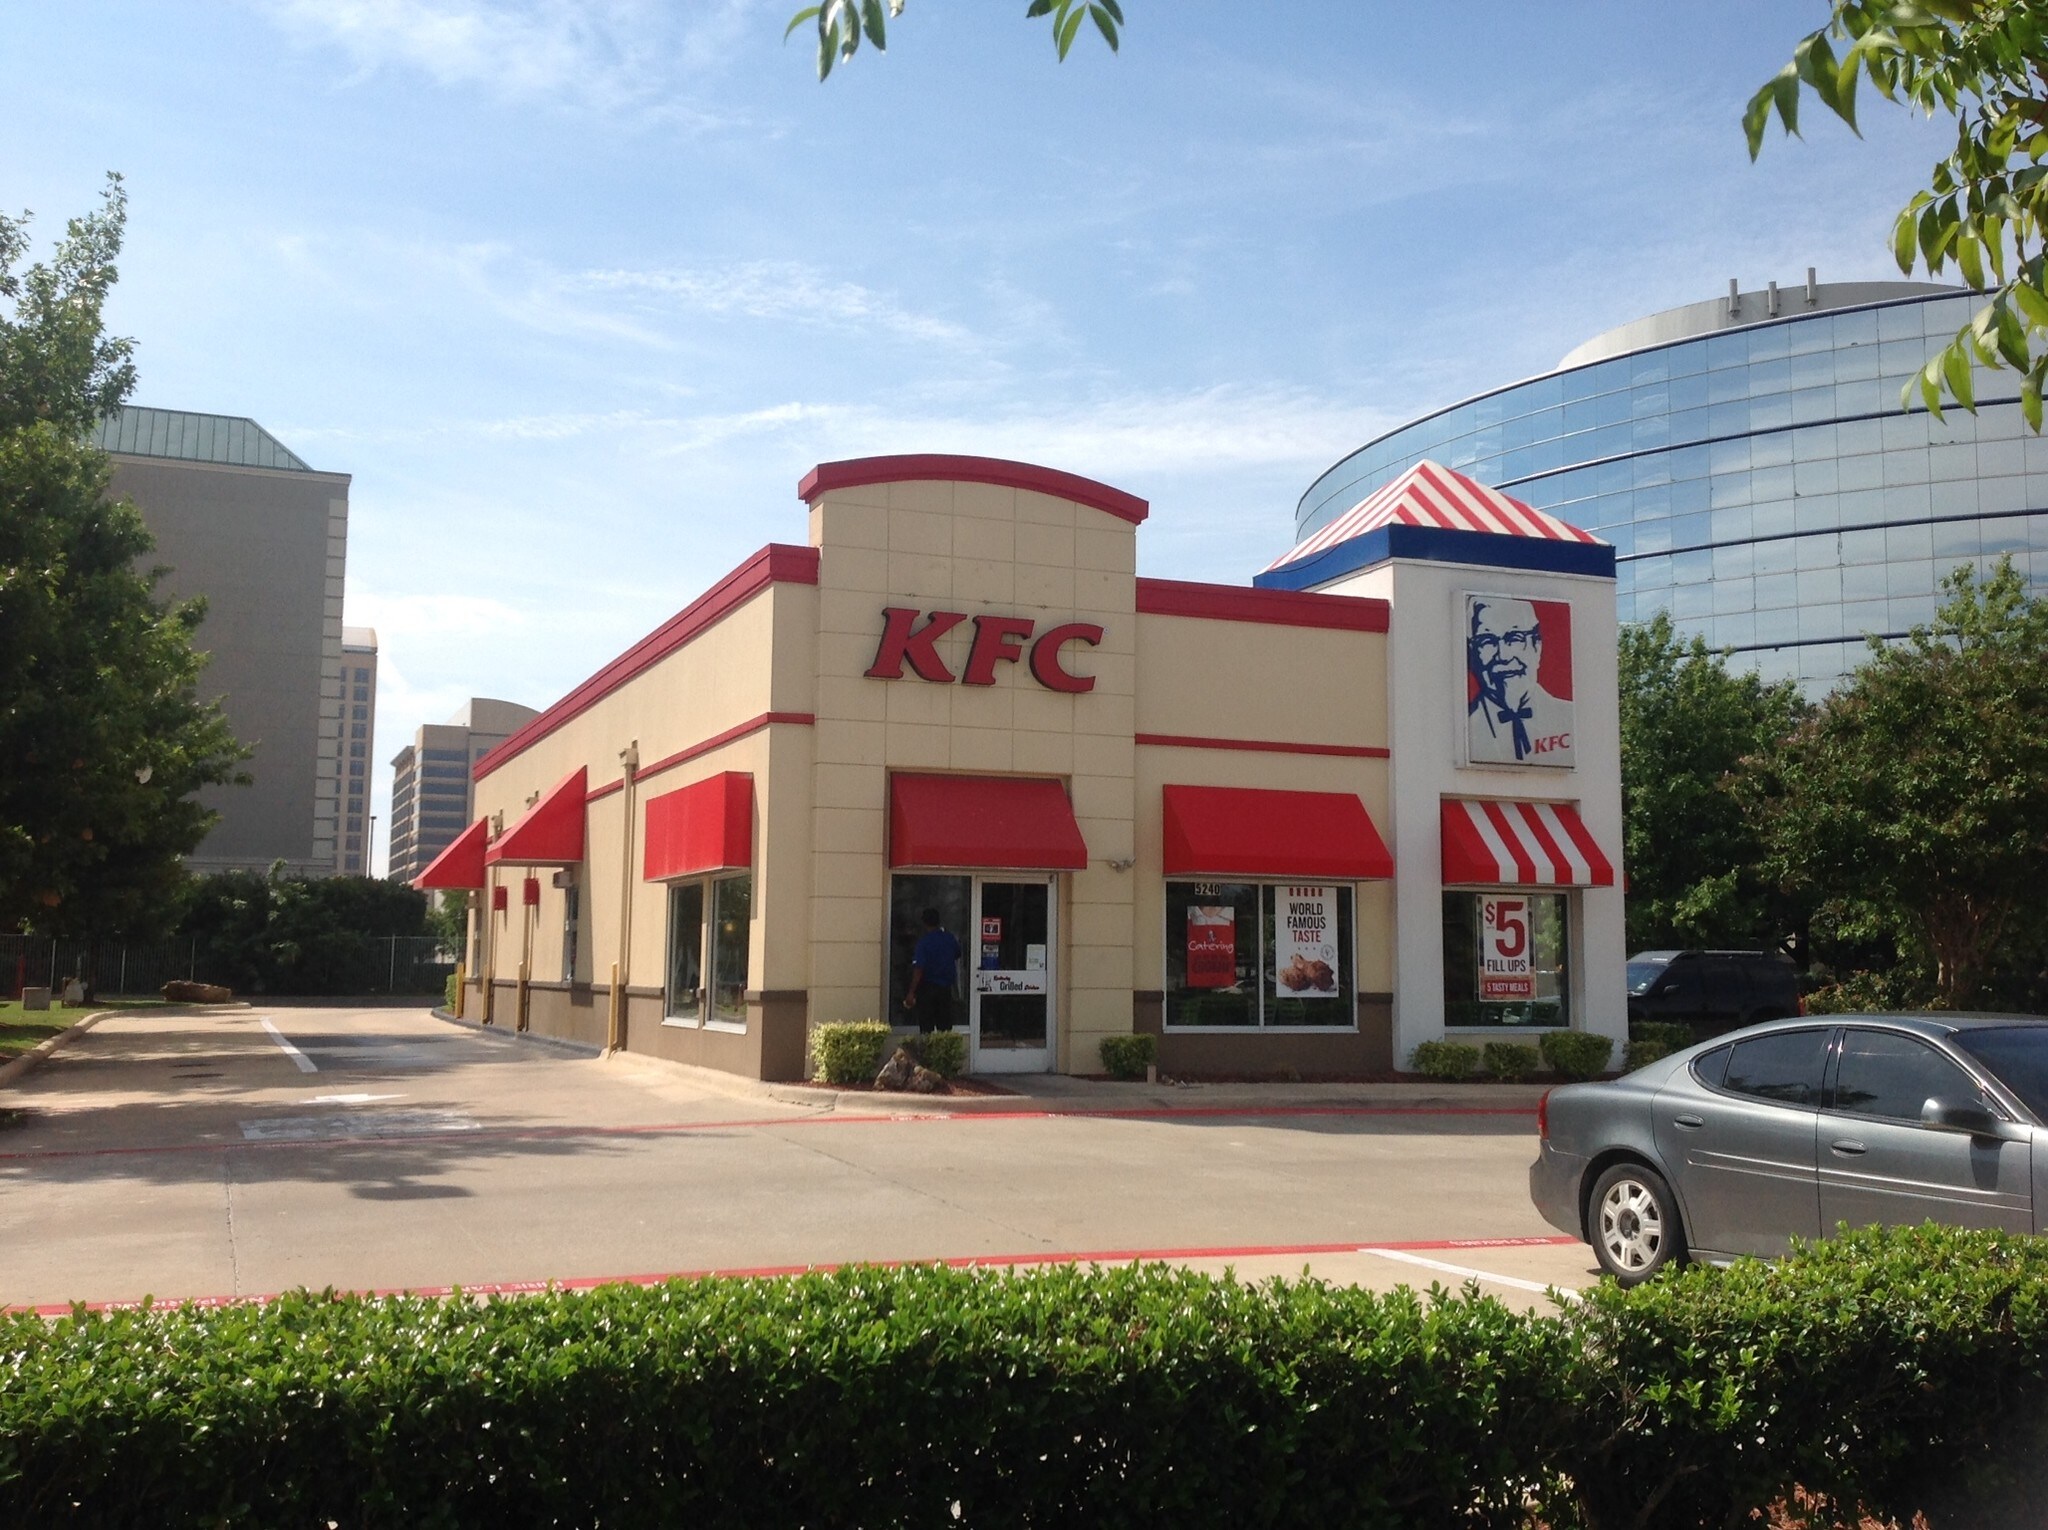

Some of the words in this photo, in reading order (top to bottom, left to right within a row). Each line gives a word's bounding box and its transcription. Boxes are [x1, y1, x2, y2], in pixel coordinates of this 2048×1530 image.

[863, 607, 1104, 693] KFC
[1534, 733, 1570, 754] KFC
[1195, 883, 1220, 895] 5240
[1289, 903, 1323, 915] WORLD
[1287, 916, 1326, 929] FAMOUS
[1485, 901, 1525, 957] $5
[1292, 930, 1321, 943] TASTE
[1188, 940, 1234, 954] Catering
[1487, 960, 1505, 972] FILL
[1508, 959, 1526, 972] UPS
[1000, 981, 1023, 991] Grilled
